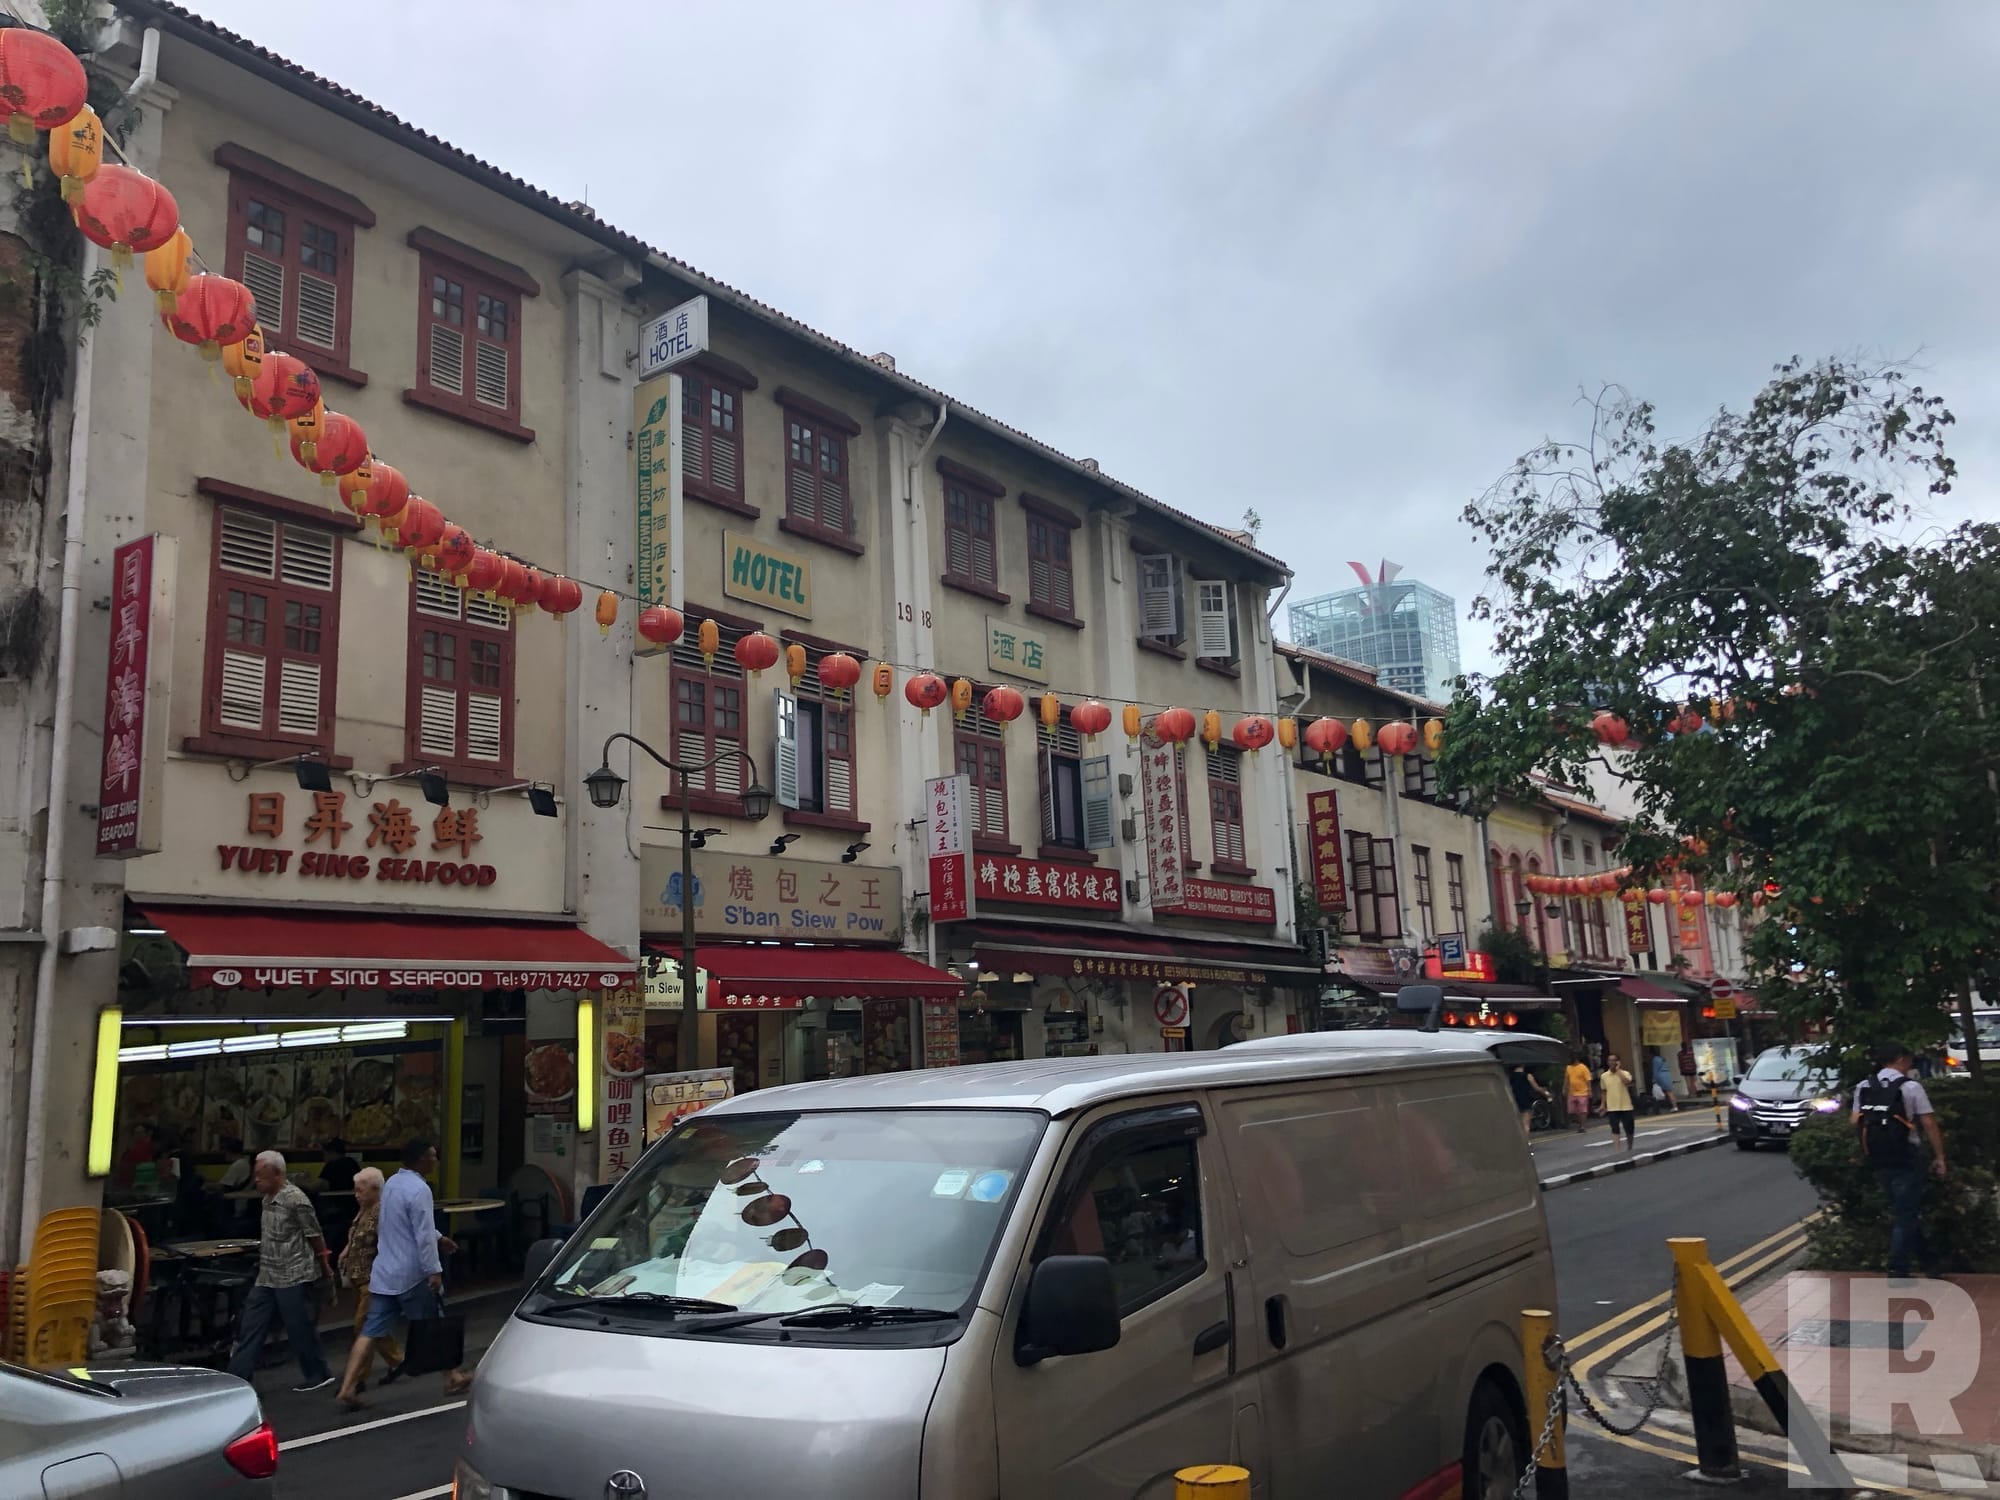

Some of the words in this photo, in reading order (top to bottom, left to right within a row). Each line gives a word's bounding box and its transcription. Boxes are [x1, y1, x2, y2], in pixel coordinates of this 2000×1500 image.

[655, 312, 689, 343] 酒店
[649, 332, 693, 367] HOTEL
[640, 431, 651, 470] HOTEL
[640, 476, 651, 510] POINT
[640, 515, 651, 590] CHINATOWN
[732, 546, 806, 605] HOTEL
[993, 629, 1044, 669] 酒店
[101, 804, 119, 821] YUET
[119, 800, 137, 817] SING
[248, 791, 484, 859] 日昇海鮮
[100, 822, 135, 842] SEAFOOD
[217, 845, 293, 873] YUET
[299, 851, 371, 879] SING
[375, 857, 498, 887] SEAFOOD
[728, 864, 882, 910] 燒包之王
[1185, 883, 1202, 898] EE'S
[1203, 886, 1229, 901] BRAND
[1230, 889, 1253, 904] BIRD'S
[1254, 892, 1271, 906] NEST
[724, 905, 780, 927] S'ban
[791, 908, 837, 929] Siew
[847, 912, 884, 931] Pow
[220, 971, 236, 982] 70
[255, 969, 319, 985] YUET
[330, 970, 379, 986] SING
[389, 970, 483, 986] SEAFOOD
[556, 974, 590, 987] 7427
[658, 982, 681, 994] Siew
[607, 1079, 634, 1174] 咖哩鱼头
